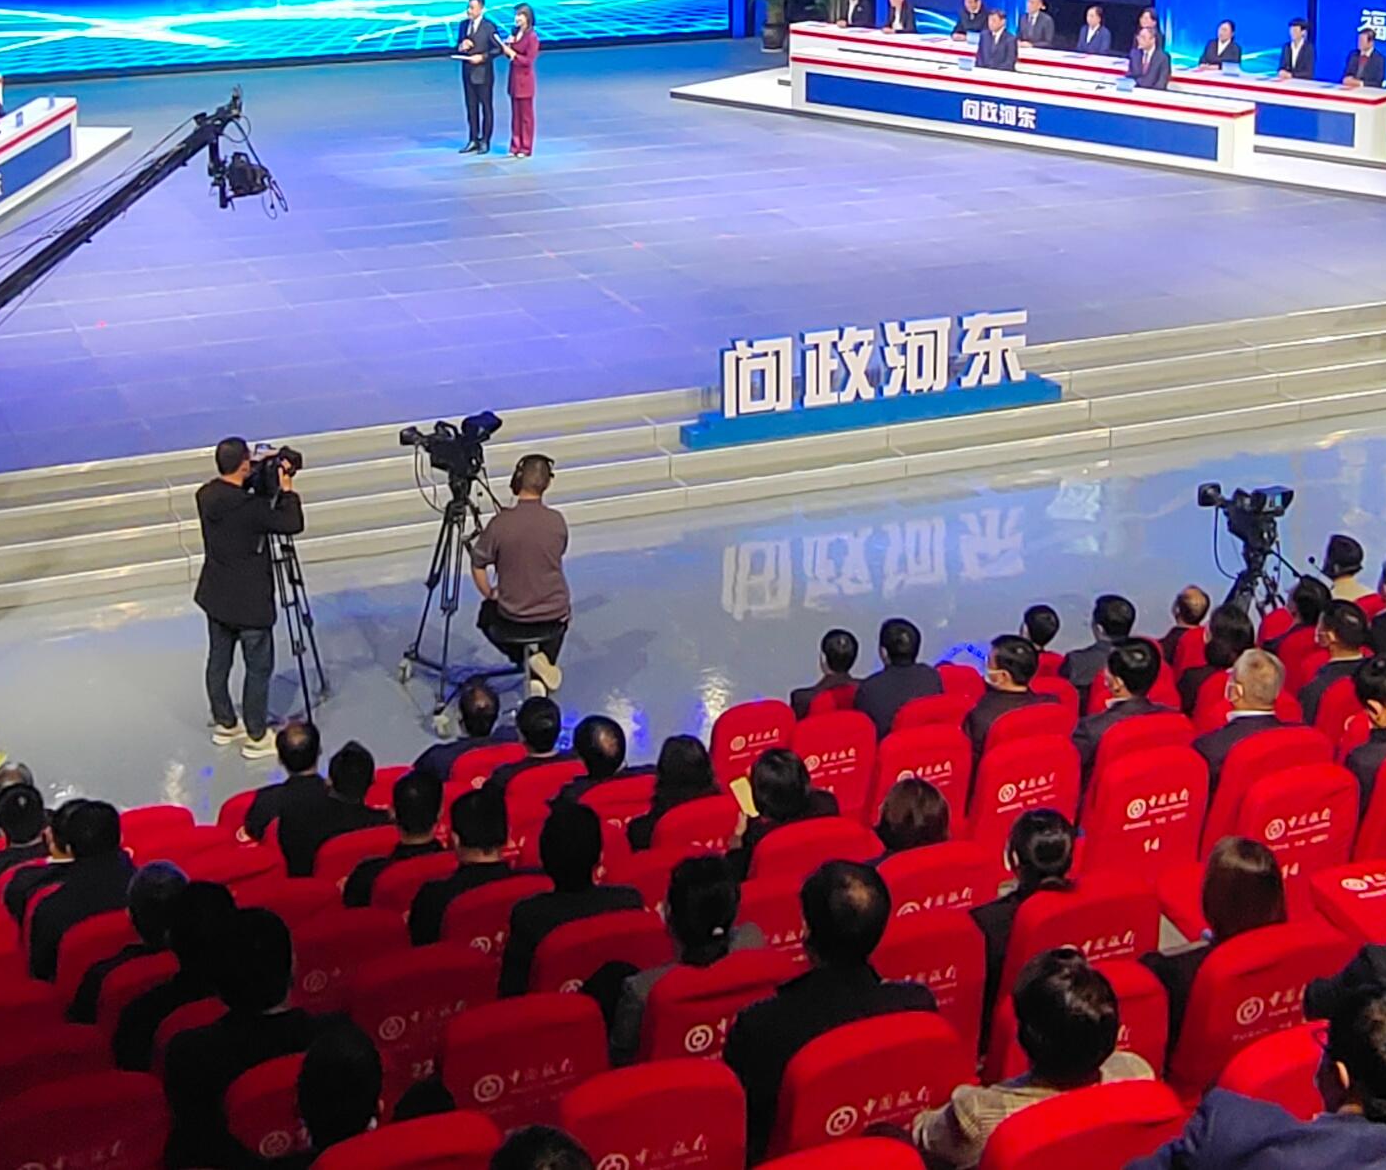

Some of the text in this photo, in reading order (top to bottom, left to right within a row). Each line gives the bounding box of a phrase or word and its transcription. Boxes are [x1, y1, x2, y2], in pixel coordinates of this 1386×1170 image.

[962, 99, 1037, 129] 问政河东
[720, 310, 1027, 418] 问政河东
